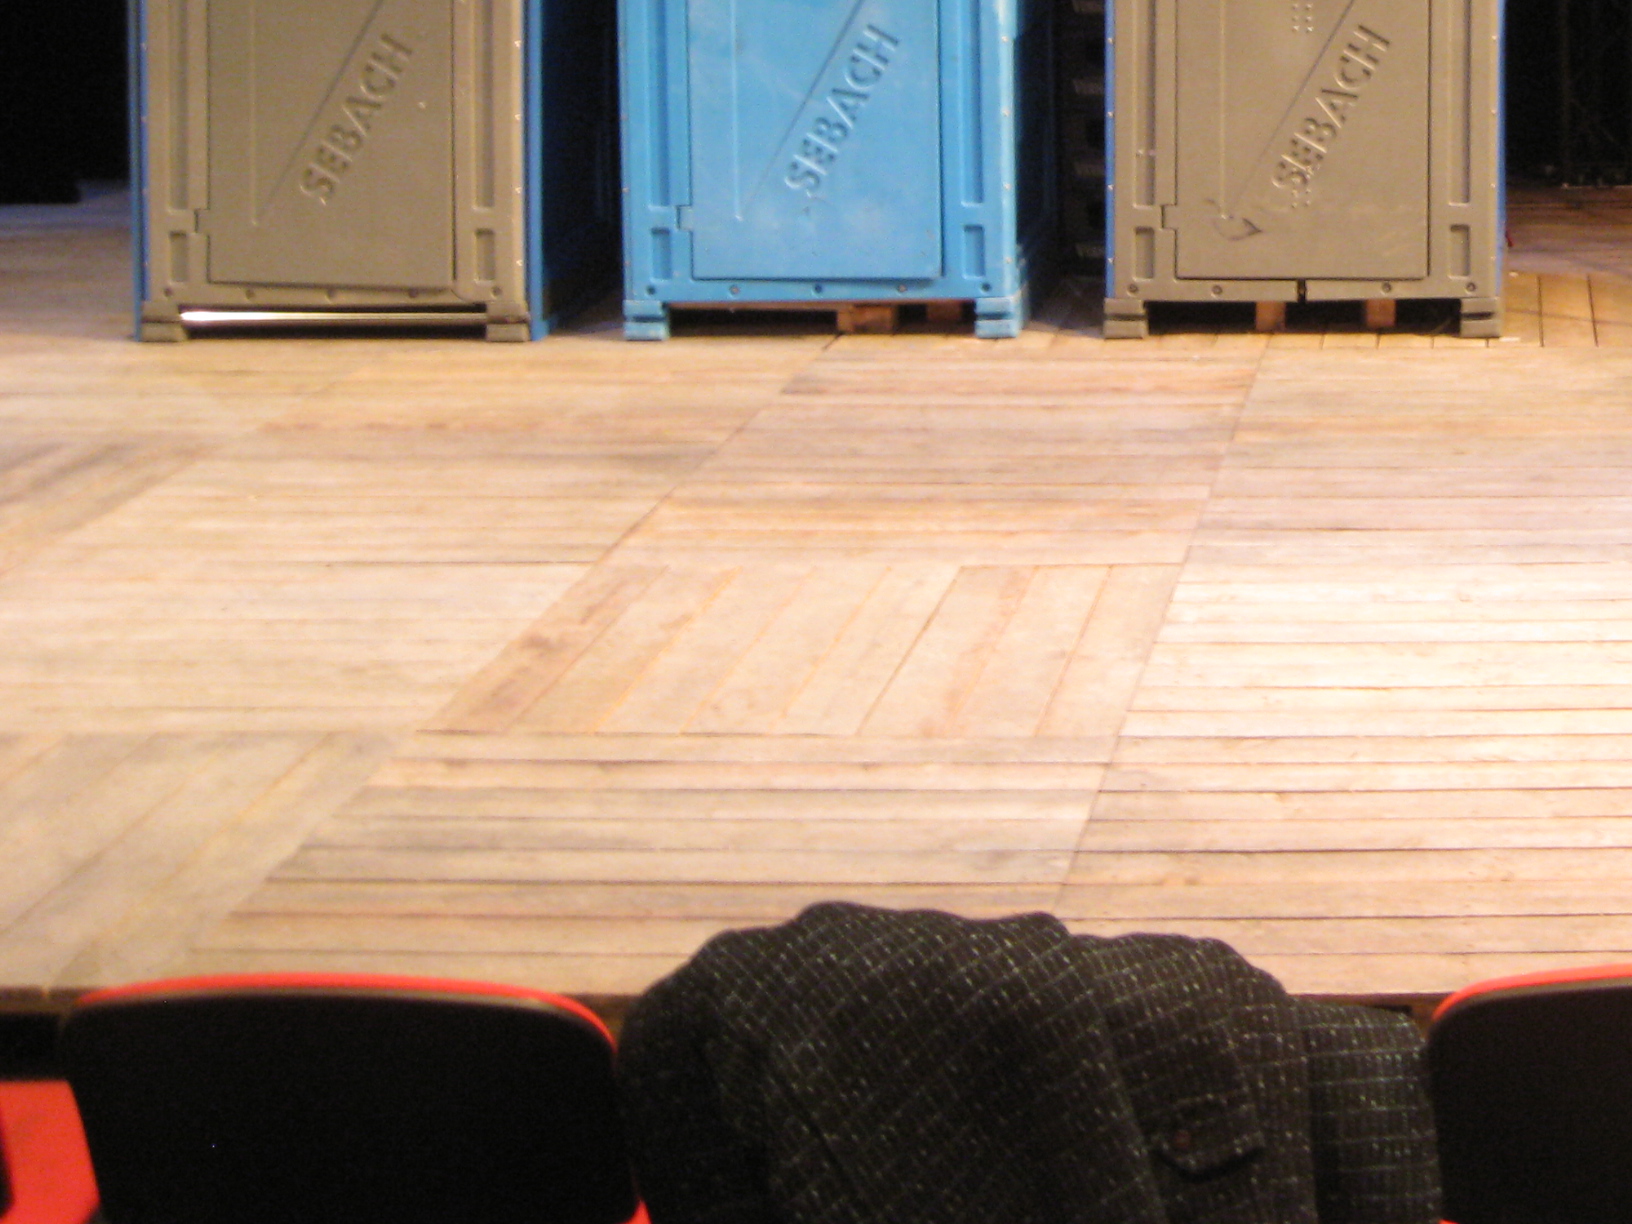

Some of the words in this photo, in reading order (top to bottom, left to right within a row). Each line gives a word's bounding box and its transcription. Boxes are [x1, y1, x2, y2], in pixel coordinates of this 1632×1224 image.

[299, 32, 414, 205] SEBACH
[783, 24, 899, 197] SEBACH
[1271, 24, 1391, 189] SEBACH
